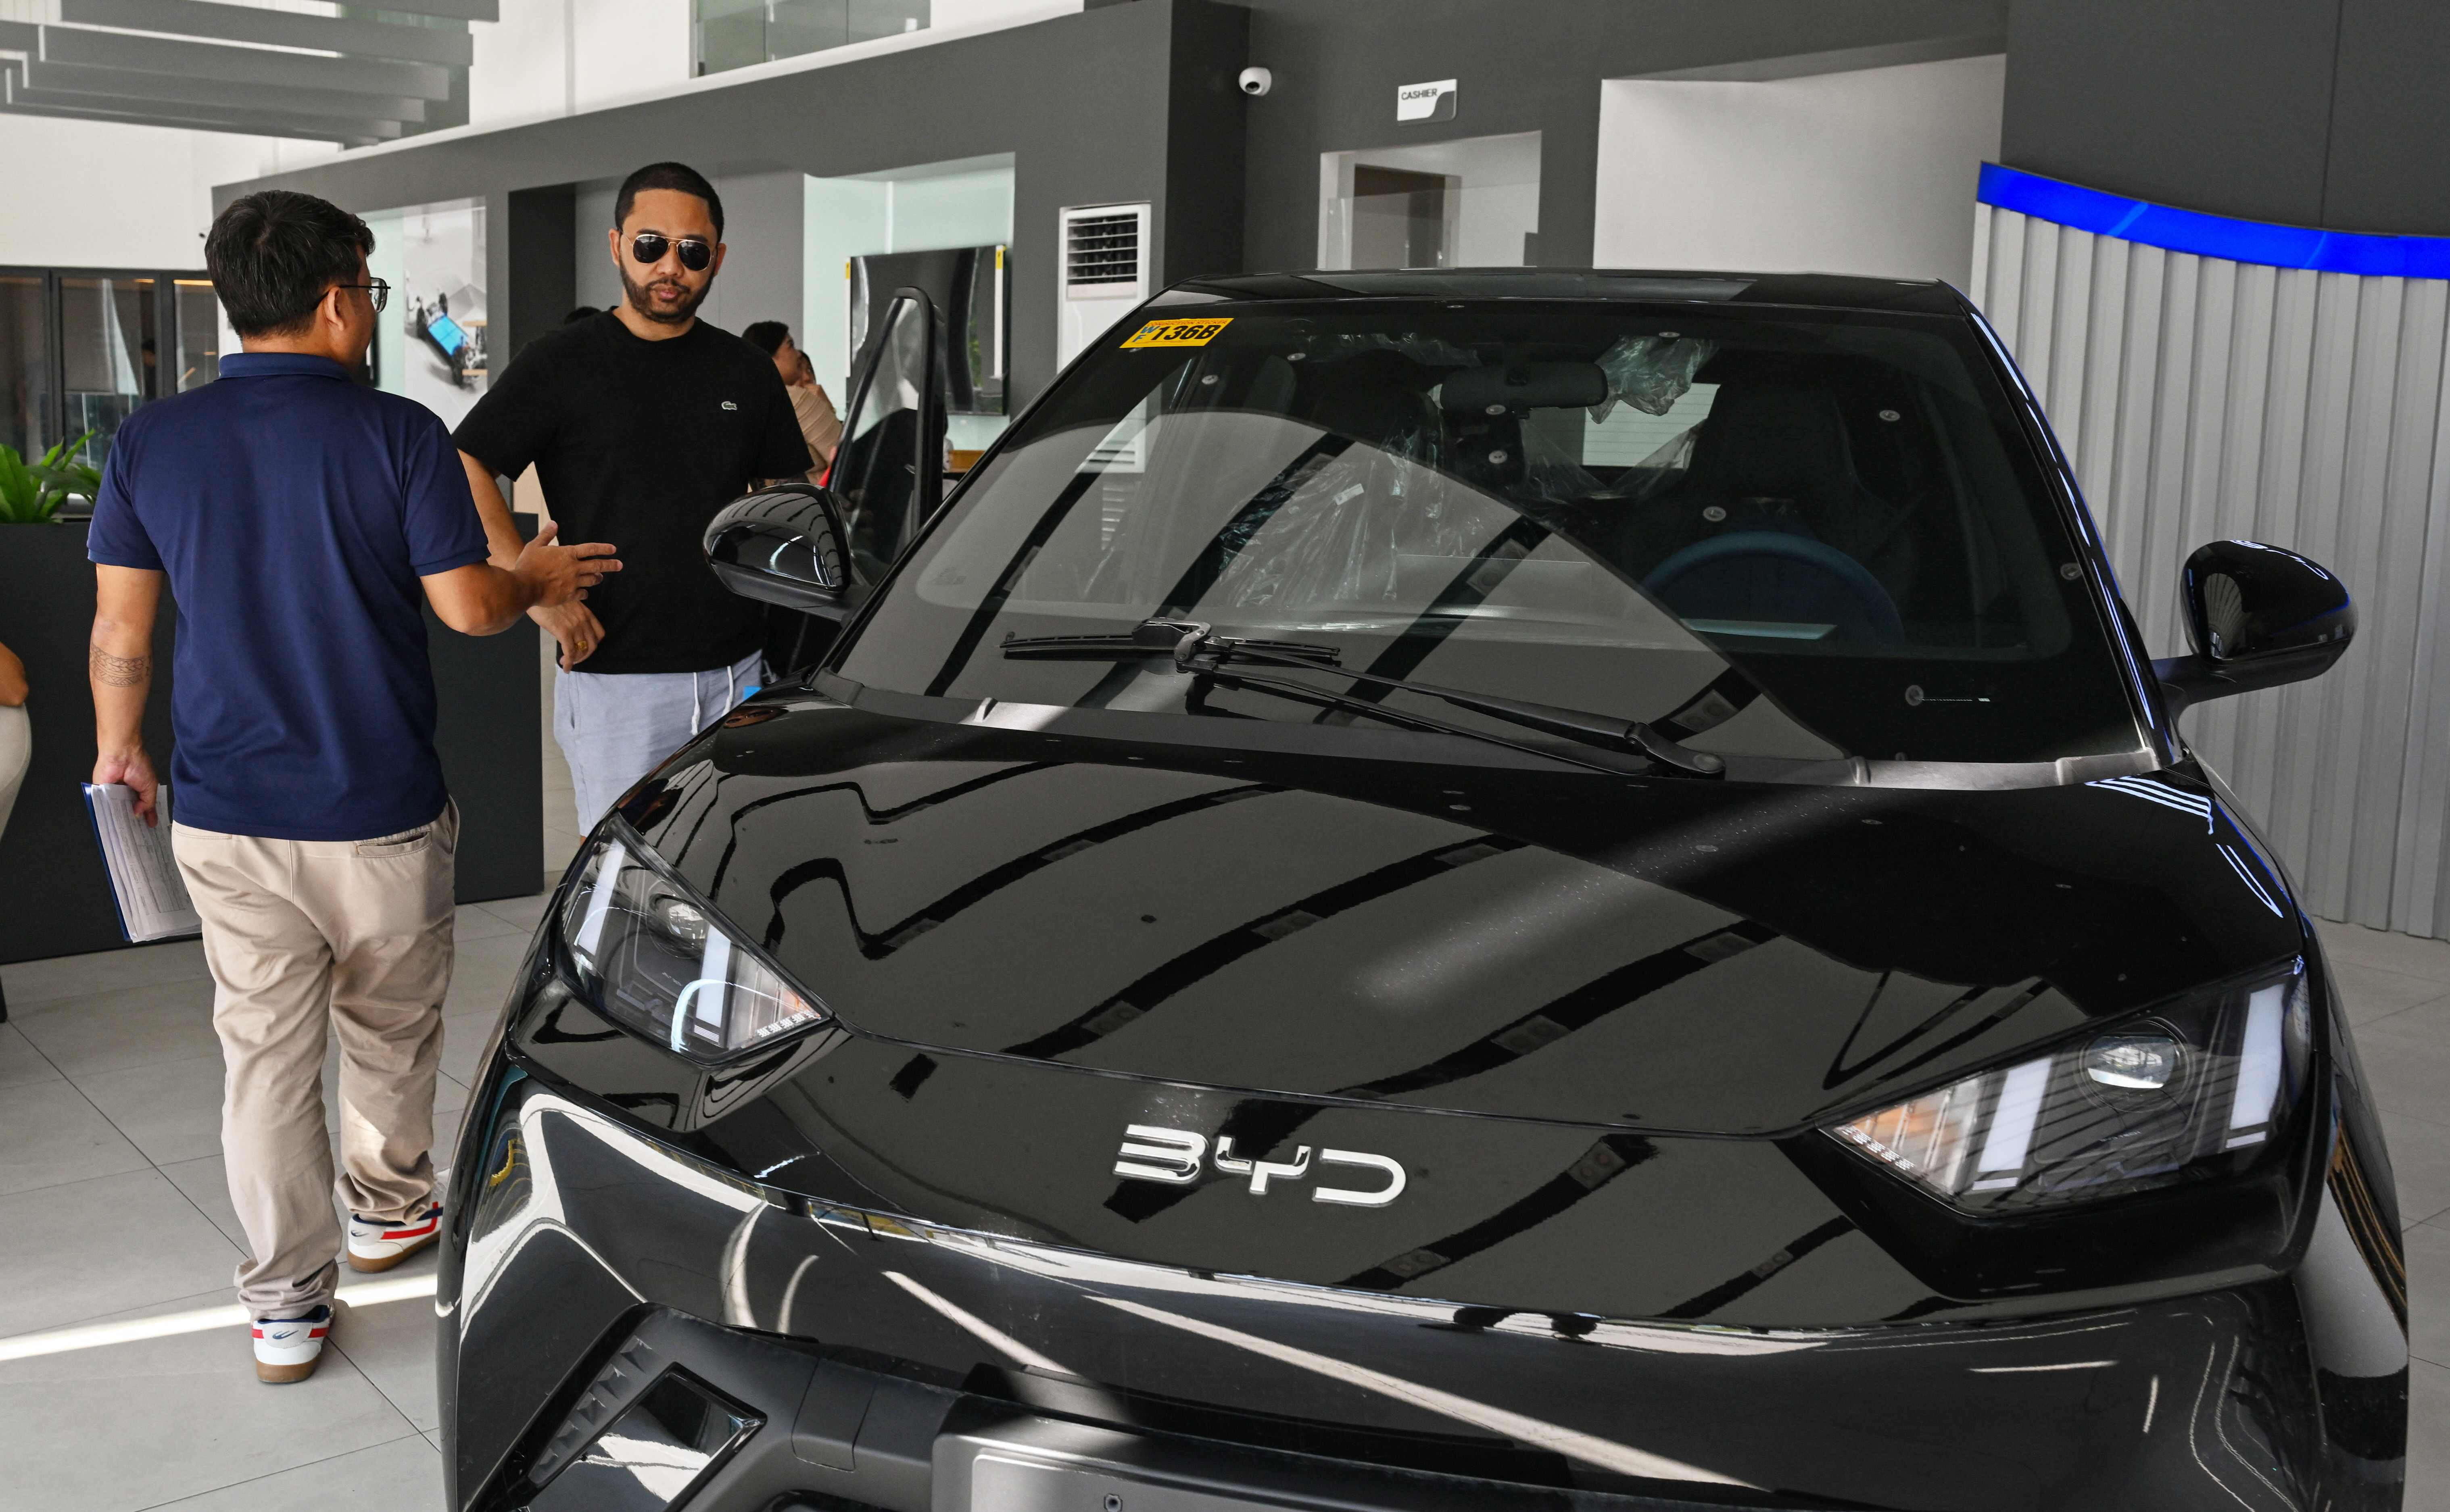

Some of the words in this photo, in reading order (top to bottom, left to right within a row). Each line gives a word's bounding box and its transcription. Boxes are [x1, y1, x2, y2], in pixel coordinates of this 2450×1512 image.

[1401, 88, 1438, 100] CASHIER
[1140, 325, 1160, 334] W
[1151, 325, 1221, 340] 136B
[1132, 334, 1146, 342] F
[1112, 1124, 1407, 1208] BYD
